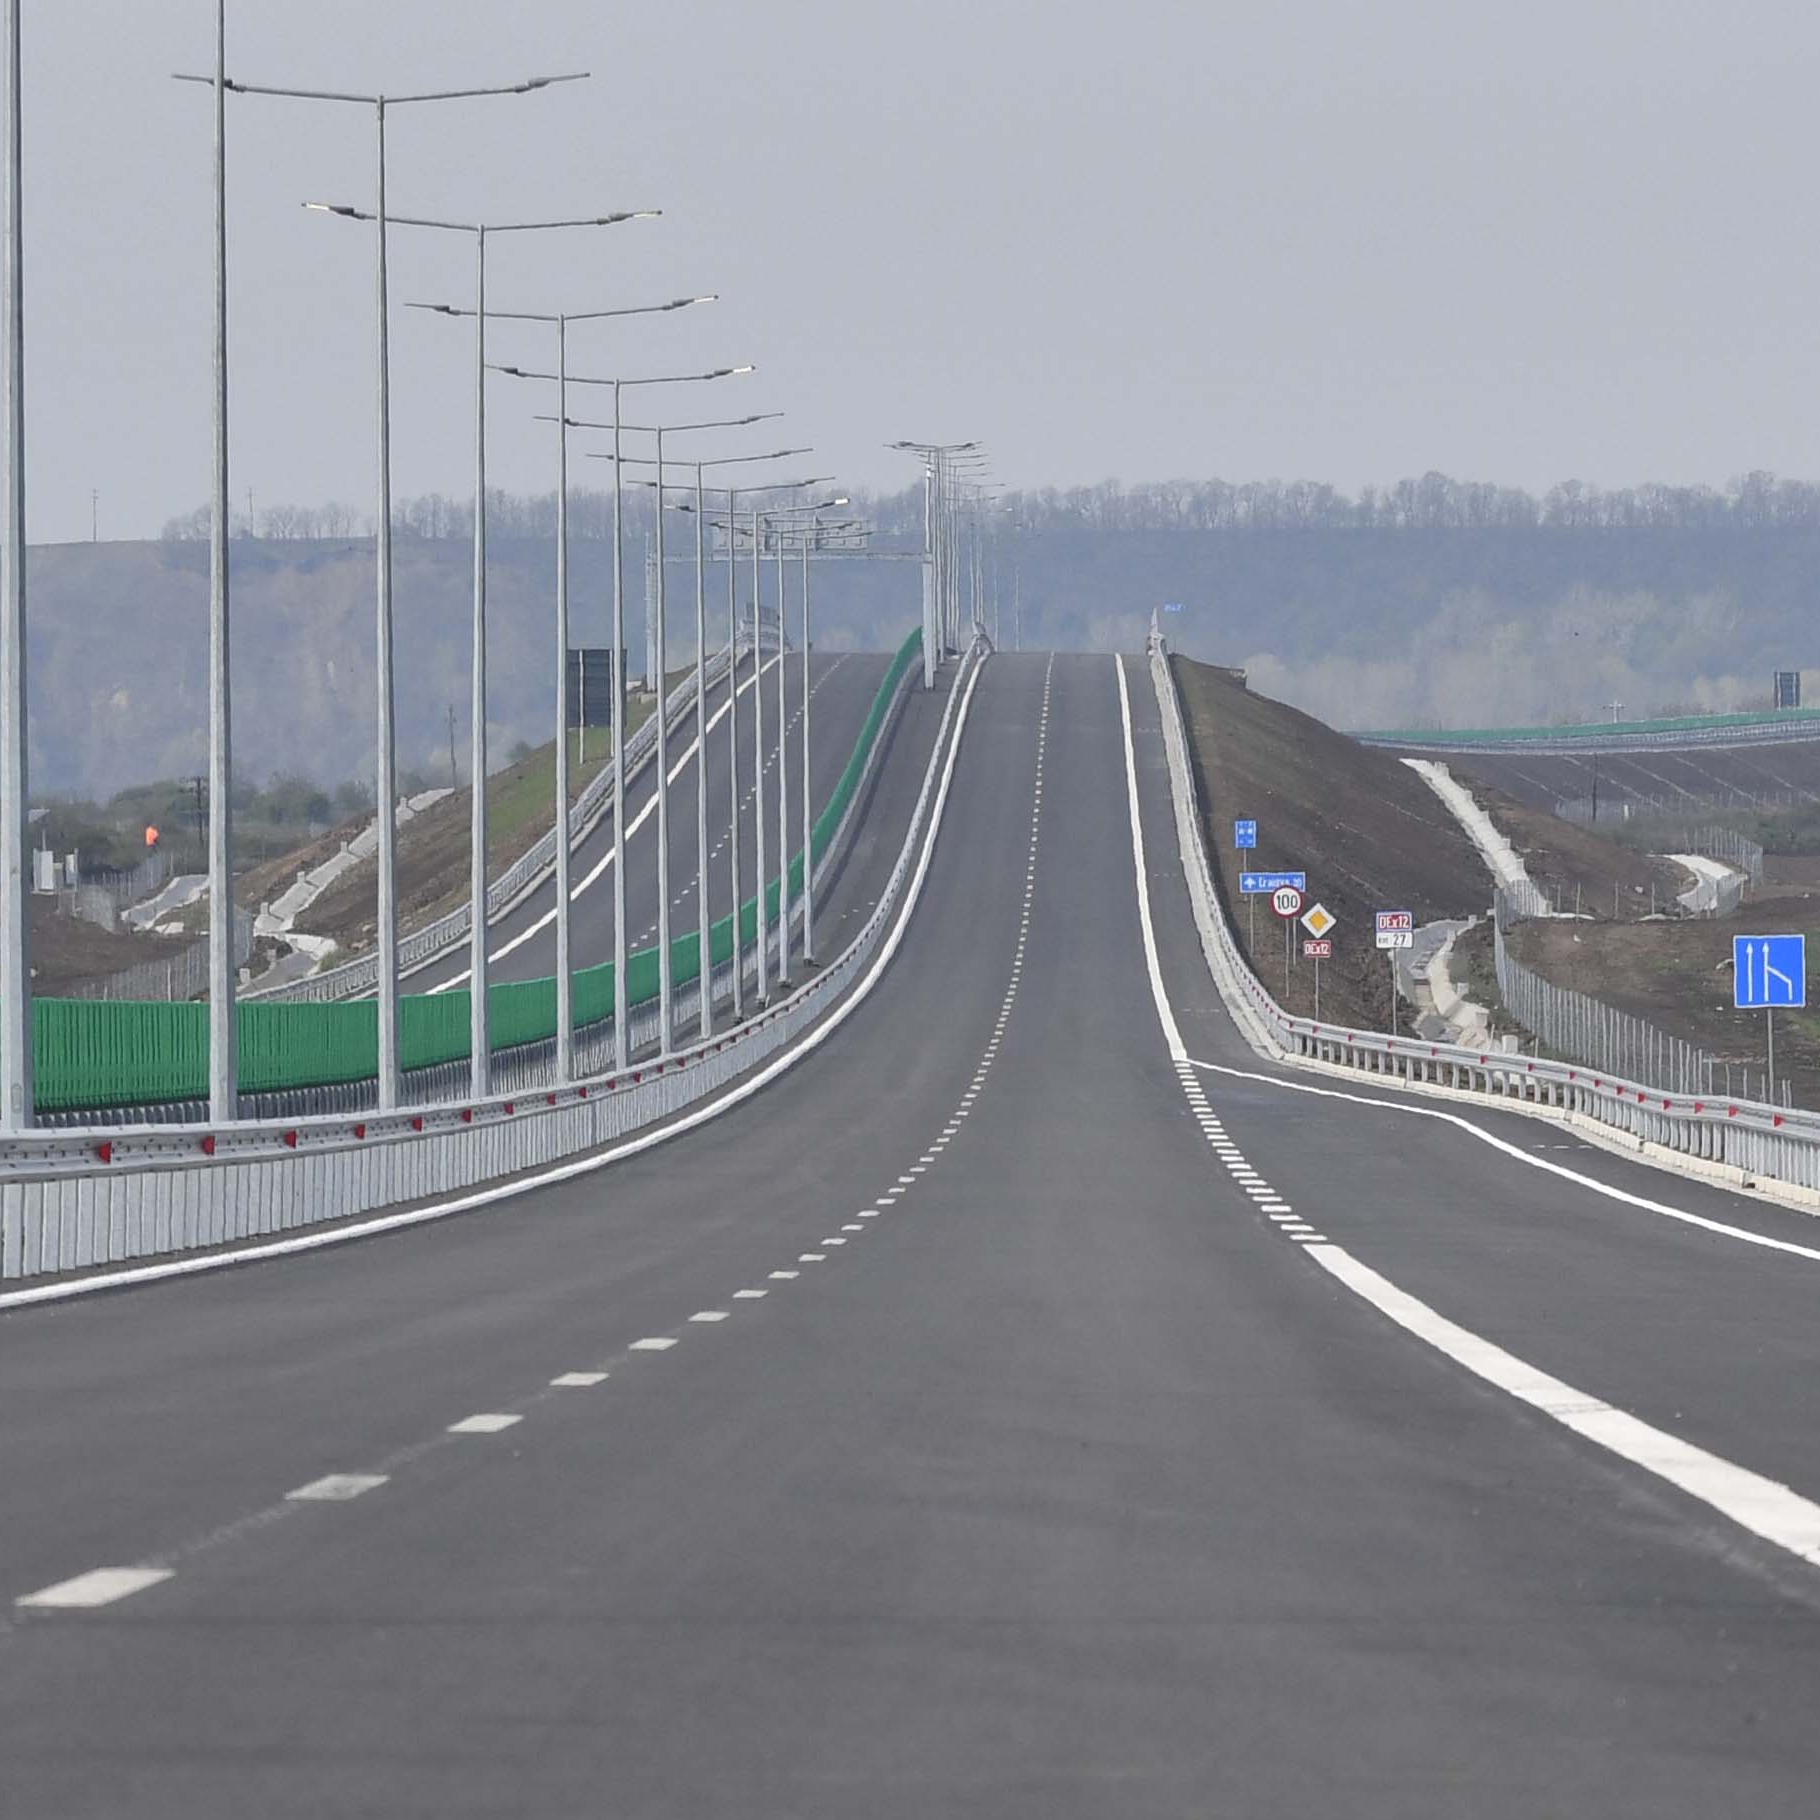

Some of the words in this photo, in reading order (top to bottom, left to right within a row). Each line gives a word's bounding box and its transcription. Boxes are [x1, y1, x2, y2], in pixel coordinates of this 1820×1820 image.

[1277, 894, 1298, 910] 100
[1379, 915, 1410, 929] DEx12
[1393, 933, 1407, 946] 27
[1305, 943, 1330, 955] DEx12
